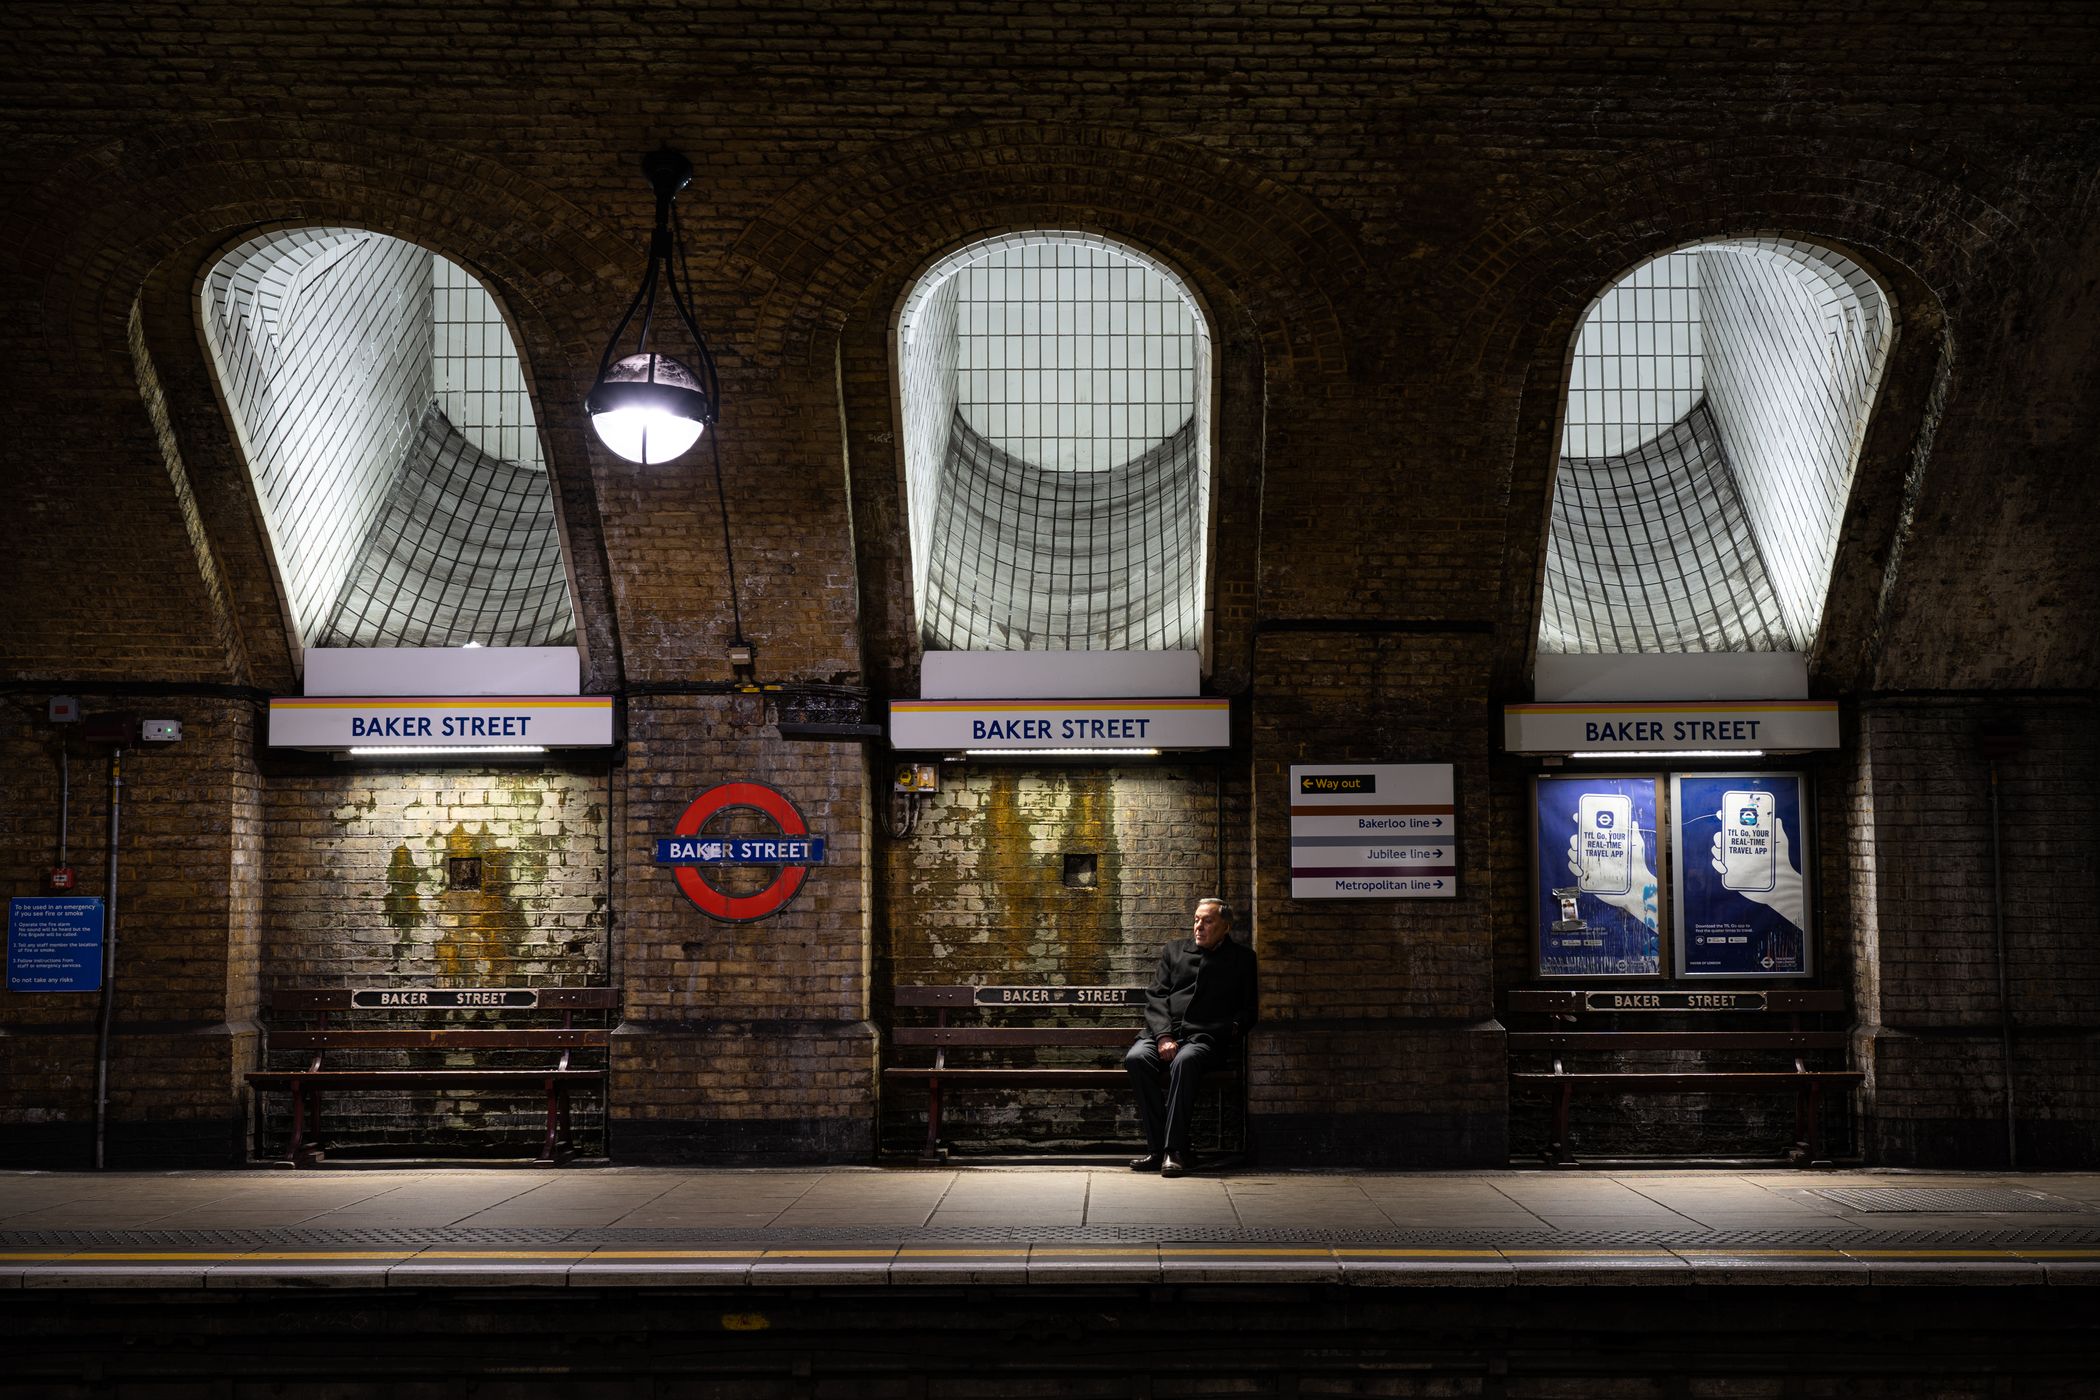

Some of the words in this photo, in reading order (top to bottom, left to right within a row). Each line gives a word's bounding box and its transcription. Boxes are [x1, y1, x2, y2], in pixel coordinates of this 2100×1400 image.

[352, 717, 433, 737] BAKER
[441, 716, 531, 736] STREET
[973, 719, 1053, 740] BAKER
[1061, 718, 1150, 739] STREET
[1586, 722, 1665, 742] BAKER
[1673, 720, 1761, 741] STREET
[1316, 778, 1339, 791] Way
[1341, 779, 1361, 788] out
[1358, 818, 1406, 829] Bakerloo
[1409, 818, 1430, 828] line
[1584, 832, 1595, 840] TfL
[1608, 832, 1626, 841] YOUR
[1728, 829, 1738, 837] TfL
[1740, 829, 1751, 838] Go,
[1587, 841, 1622, 849] REAL-TIME
[1731, 838, 1765, 846] REAL-TIME
[669, 843, 734, 859] BAKER
[741, 842, 812, 858] STREET
[1367, 849, 1407, 859] Jubilee
[1410, 849, 1431, 859] line
[1585, 849, 1609, 858] TRAVEL
[1610, 850, 1624, 858] APP
[1729, 847, 1753, 855] TRAVEL
[1754, 847, 1768, 855] APP
[1335, 880, 1407, 892] Metropolitan
[1410, 880, 1431, 890] line
[381, 992, 429, 1005] BAKER
[456, 992, 507, 1005] STREET
[1003, 990, 1049, 1002] BAKER
[1077, 990, 1127, 1002] STREET
[1614, 995, 1660, 1007] BAKER
[1687, 995, 1736, 1007] STREET
